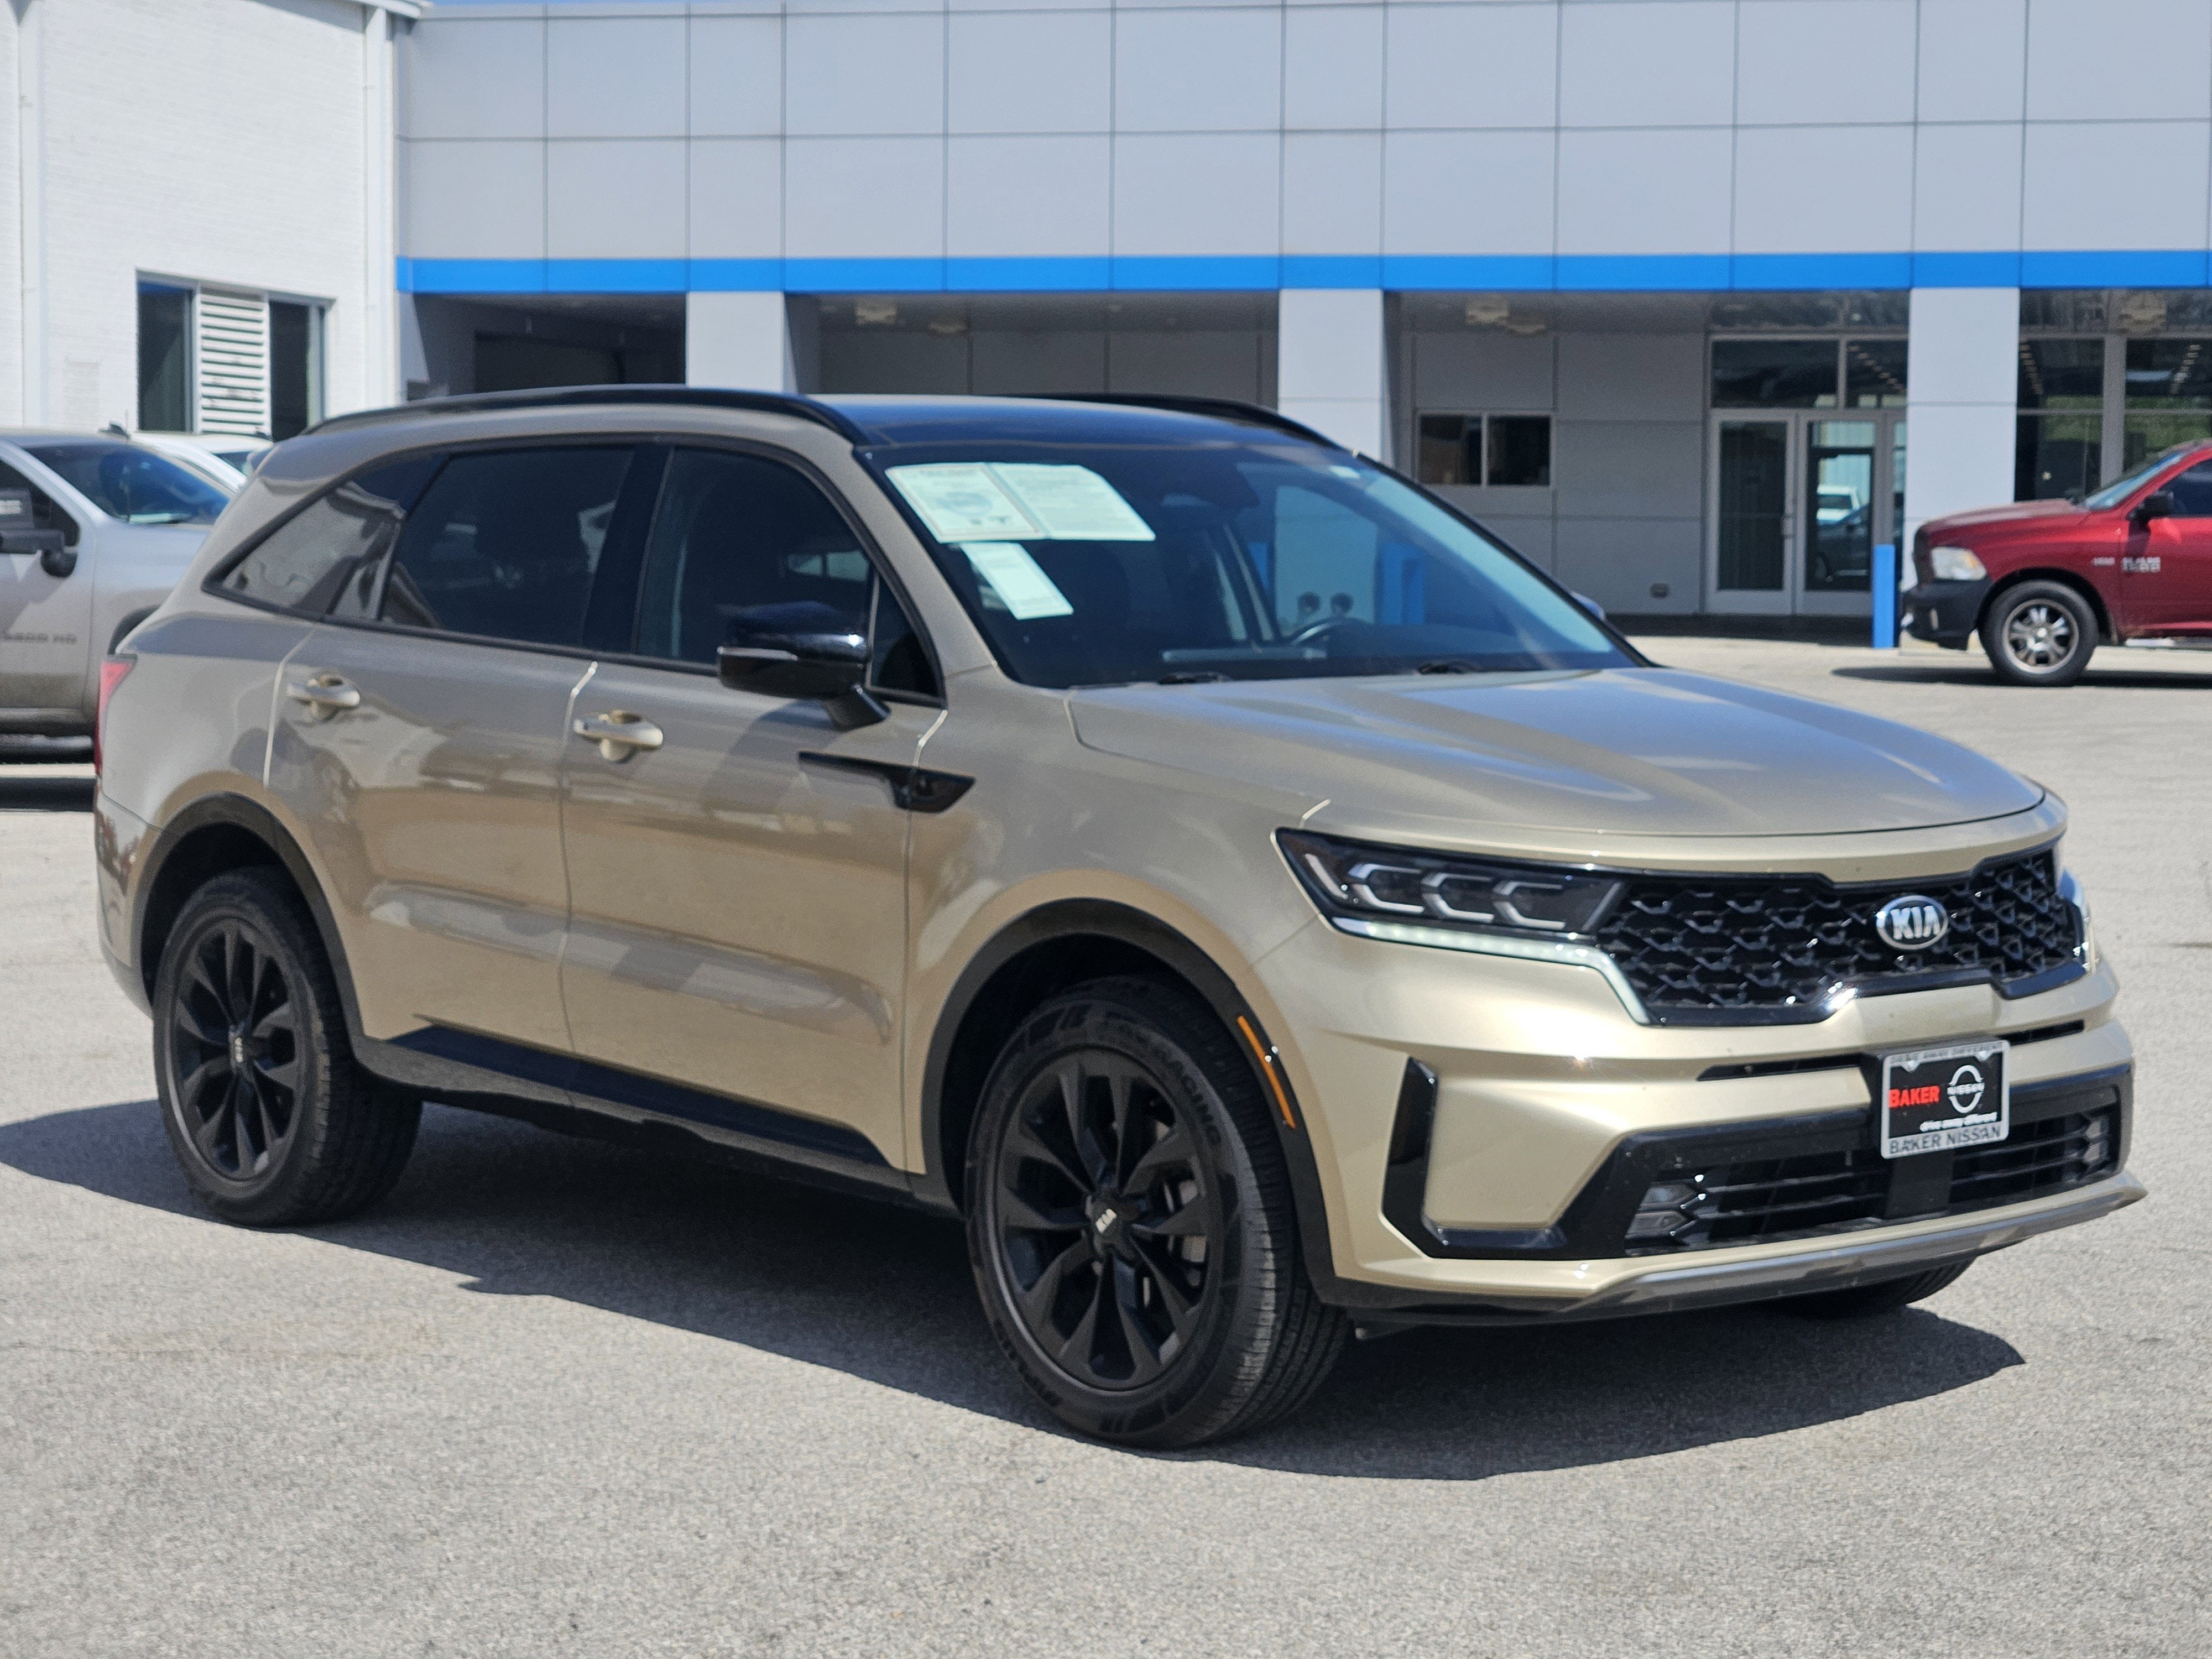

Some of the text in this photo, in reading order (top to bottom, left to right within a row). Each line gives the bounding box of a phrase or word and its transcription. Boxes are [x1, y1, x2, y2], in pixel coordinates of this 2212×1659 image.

[1890, 905, 1940, 940] KIA
[1889, 1085, 1940, 1108] BAKER
[1947, 1082, 1985, 1095] NISSAN
[1890, 1126, 2001, 1154] BAKER NISSAN
